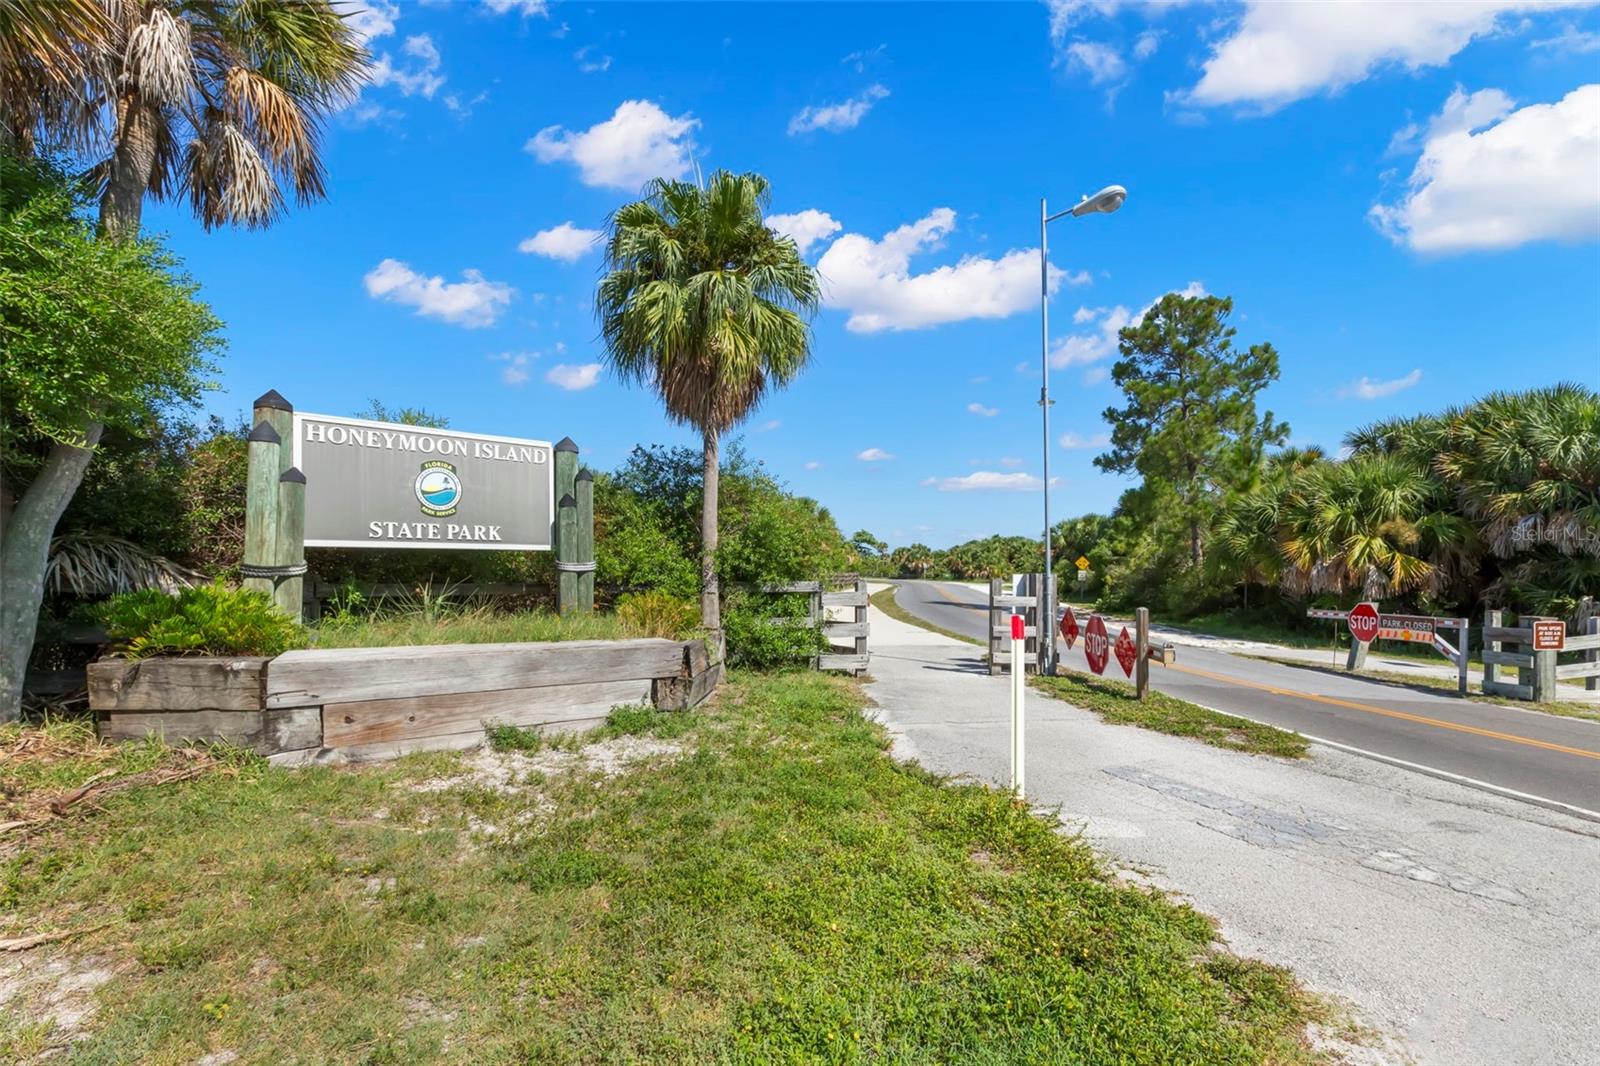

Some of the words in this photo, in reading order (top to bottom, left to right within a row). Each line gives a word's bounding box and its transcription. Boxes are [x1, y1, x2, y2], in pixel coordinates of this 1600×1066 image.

[305, 423, 468, 457] HONEYMOON
[474, 442, 547, 464] ISLAND
[422, 506, 435, 515] PARK
[436, 508, 456, 516] SERVICE
[368, 521, 441, 540] STATE
[447, 523, 502, 541] PARK
[1350, 615, 1377, 631] STOP
[1382, 619, 1401, 629] PARK
[1404, 620, 1433, 631] CLOSED
[1086, 632, 1107, 658] STOP
